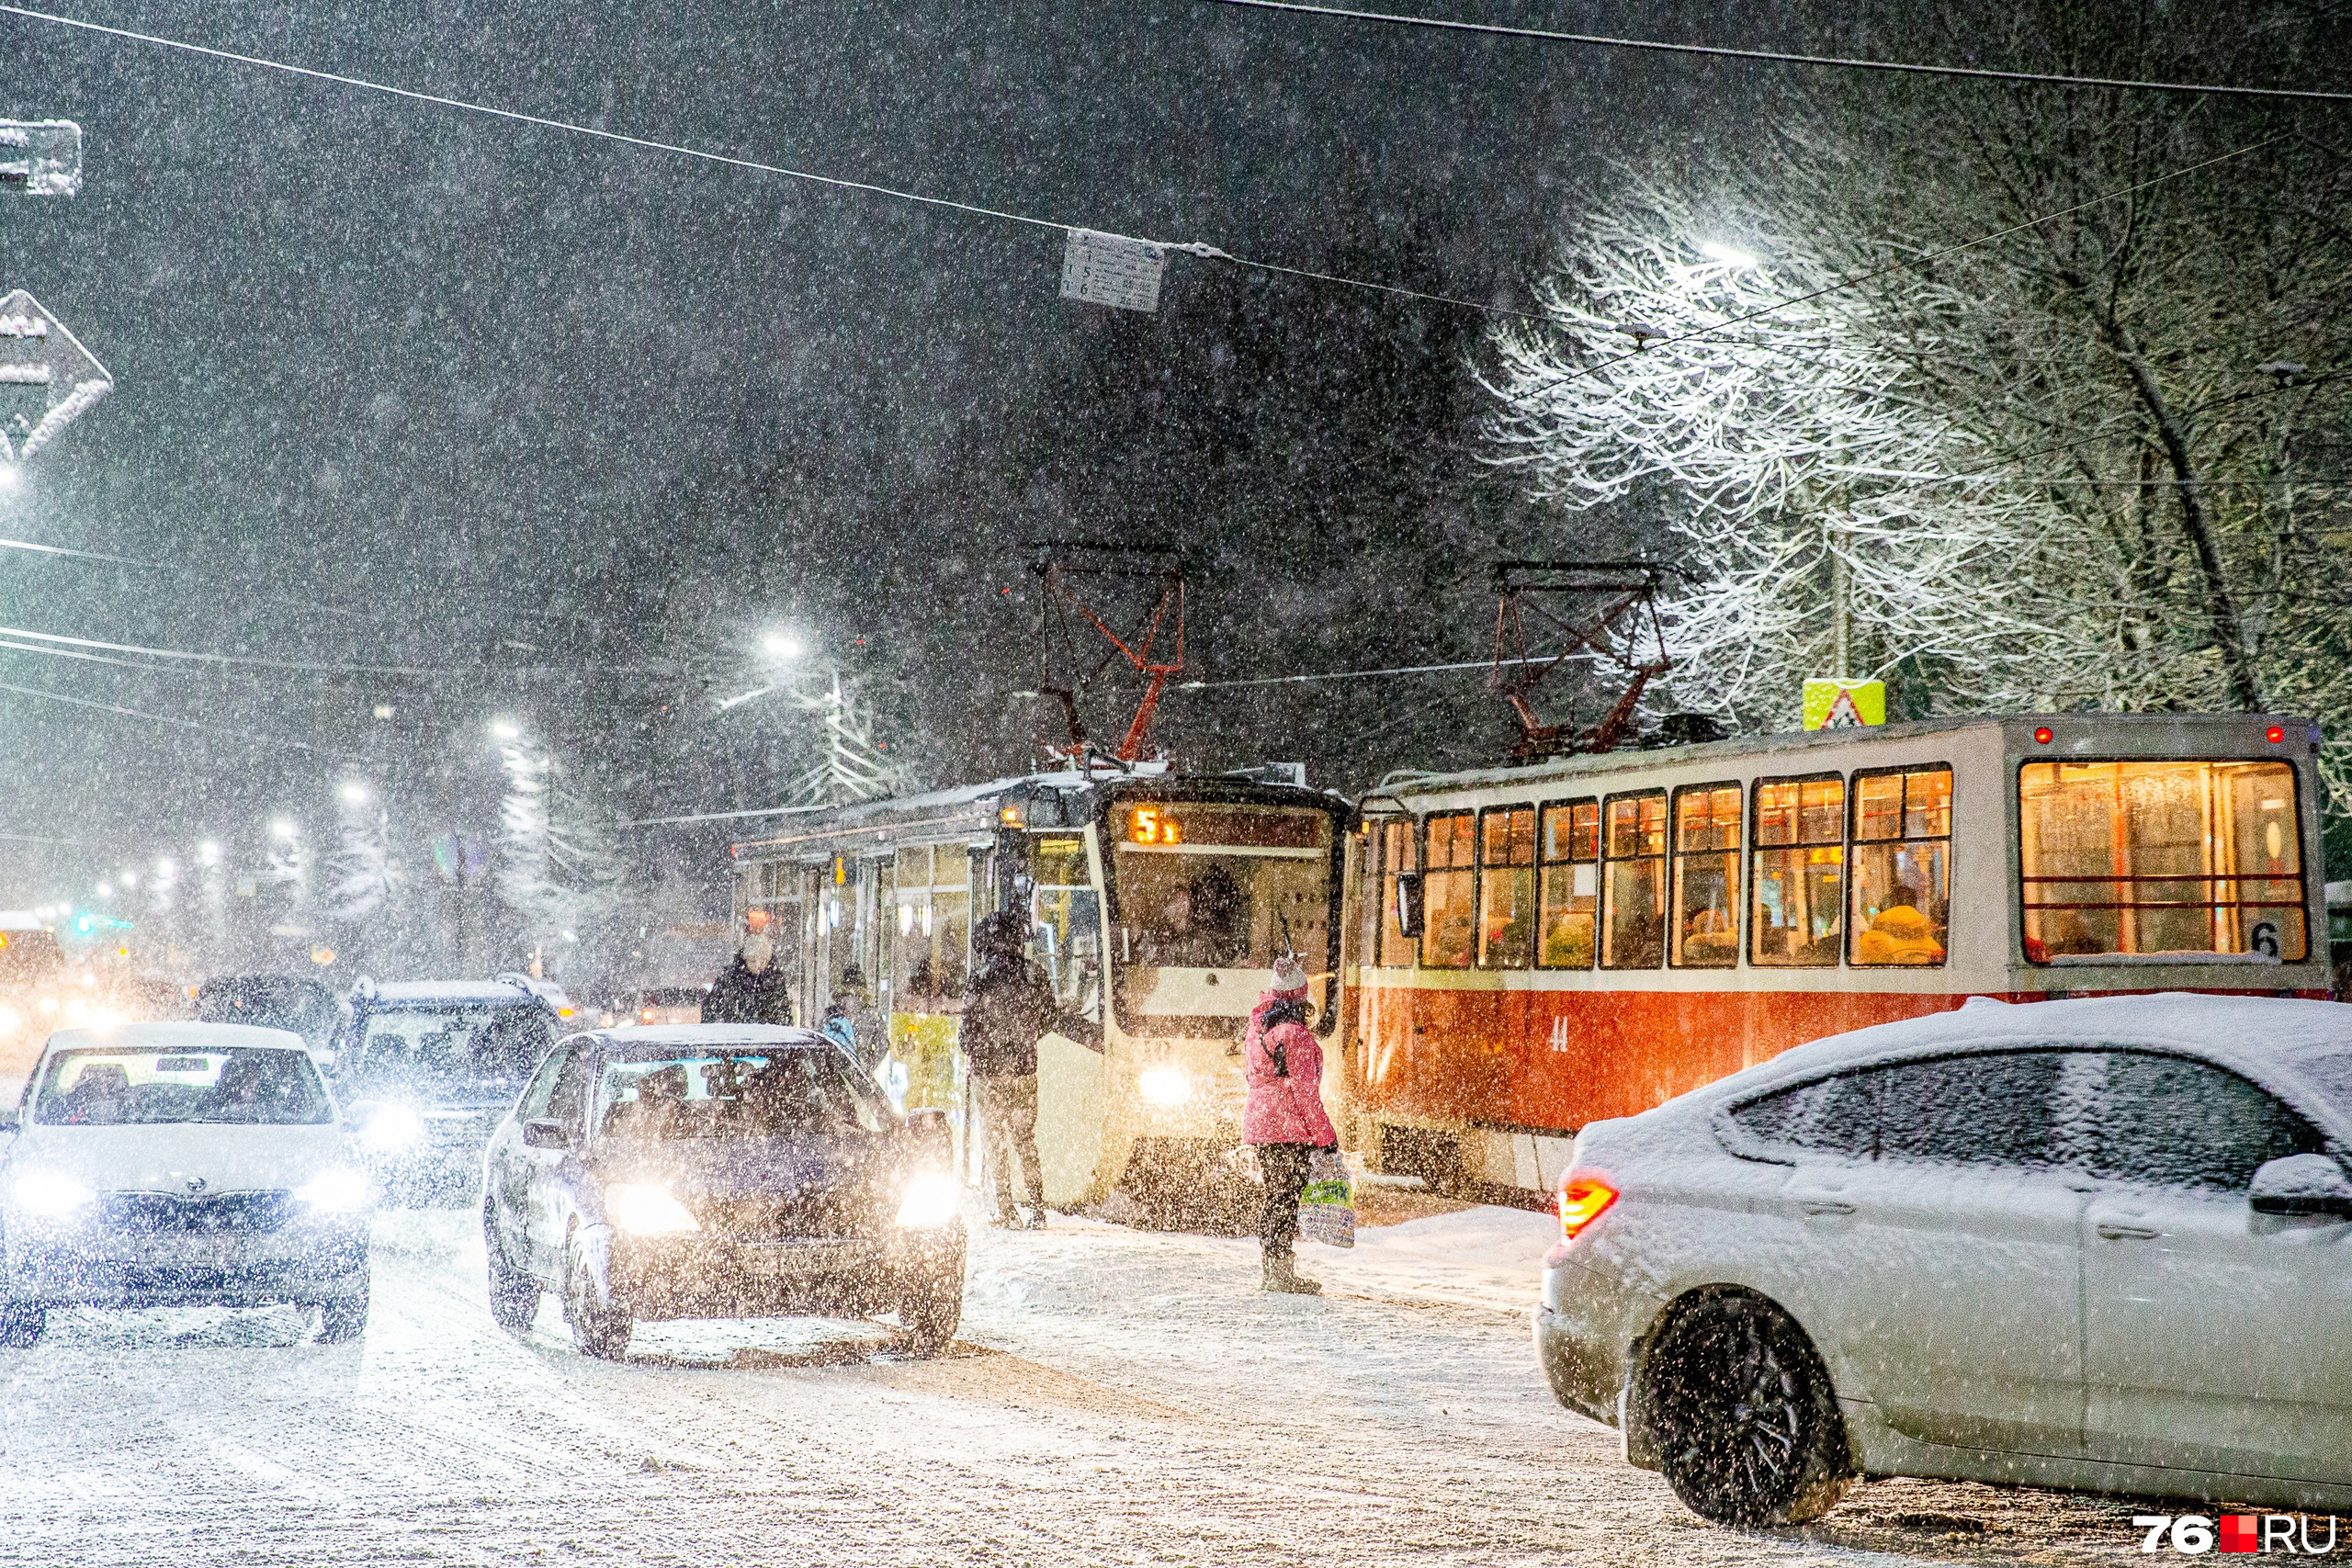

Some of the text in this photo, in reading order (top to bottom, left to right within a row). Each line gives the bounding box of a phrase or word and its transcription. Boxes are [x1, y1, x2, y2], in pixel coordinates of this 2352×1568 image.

[1080, 282, 1089, 295] 6
[1082, 265, 1091, 278] 5
[1136, 808, 1158, 842] 5
[2252, 921, 2278, 957] 6
[1548, 1015, 1568, 1053] 44
